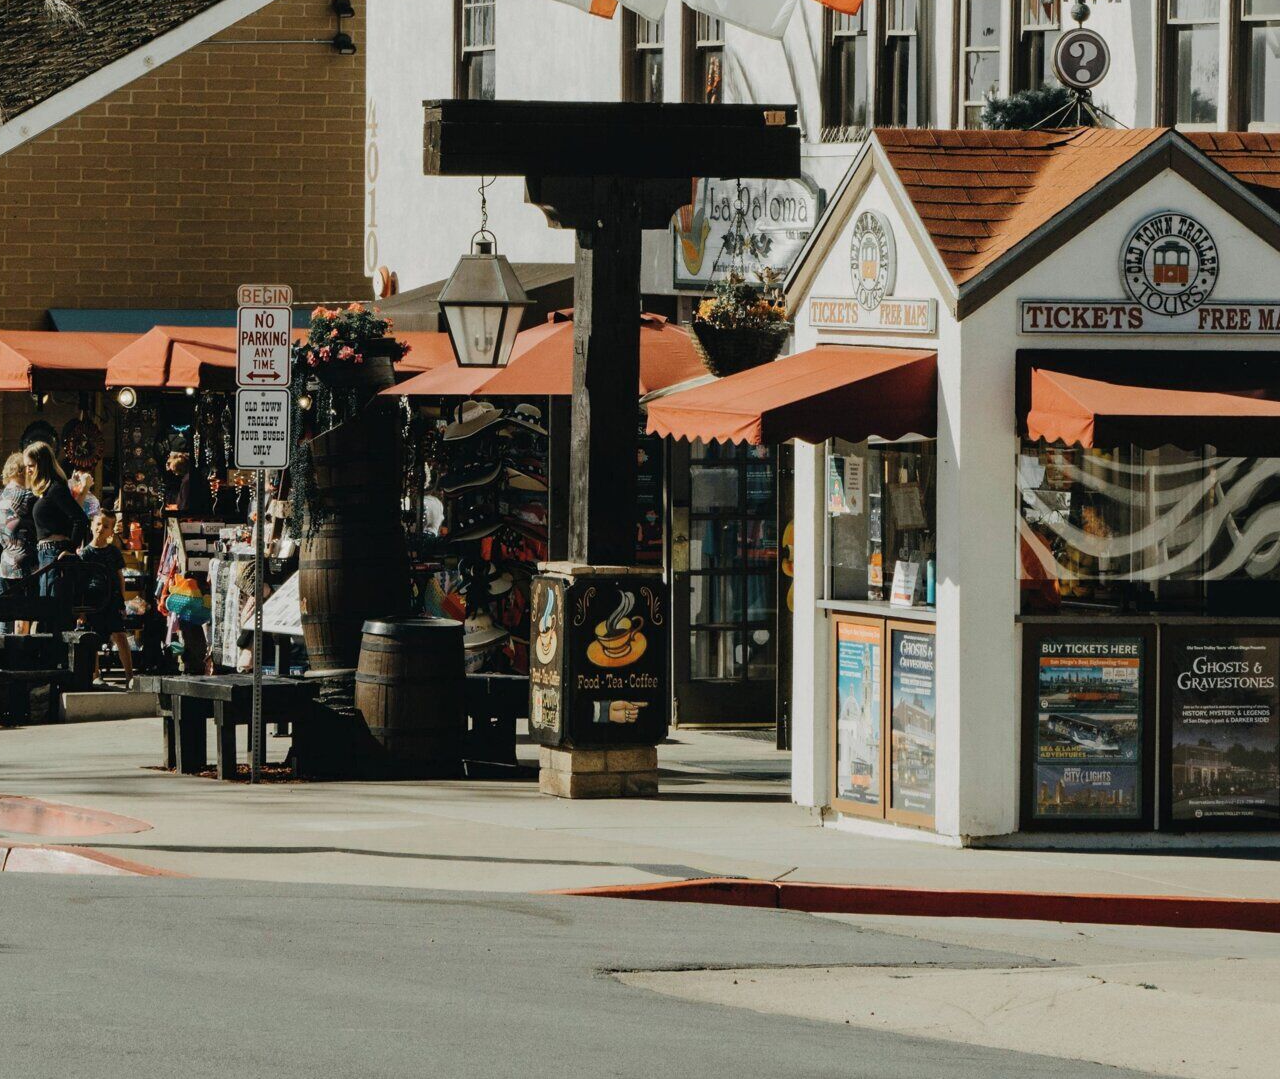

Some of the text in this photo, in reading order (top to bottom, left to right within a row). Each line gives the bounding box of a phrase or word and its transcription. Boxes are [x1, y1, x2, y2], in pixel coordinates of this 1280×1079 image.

[710, 187, 808, 222] La Paloma
[1126, 217, 1216, 277] OLD TOWN TROLLEY
[241, 289, 289, 303] BEGIN
[1137, 282, 1205, 315] TOURS
[811, 301, 859, 324] TICKETS
[880, 303, 928, 326] FREE MAPS
[1026, 306, 1144, 330] TICKETS
[1197, 308, 1251, 330] FREE
[254, 313, 275, 329] NO
[241, 331, 287, 346] PARKING
[254, 348, 275, 358] ANY
[253, 360, 275, 370] TIME
[244, 401, 282, 412] OLD TOWN
[247, 416, 279, 427] TROLLEY
[241, 430, 285, 441] TOUR BUSES
[253, 445, 272, 456] ONLY
[1042, 643, 1138, 654] BUY TICKETS HERE
[1193, 656, 1263, 675] GHOSTS &
[577, 674, 659, 689] Food Tea Coffee
[1177, 671, 1275, 692] GRAVESTONES
[1064, 771, 1112, 782] CITY LIGHTS
